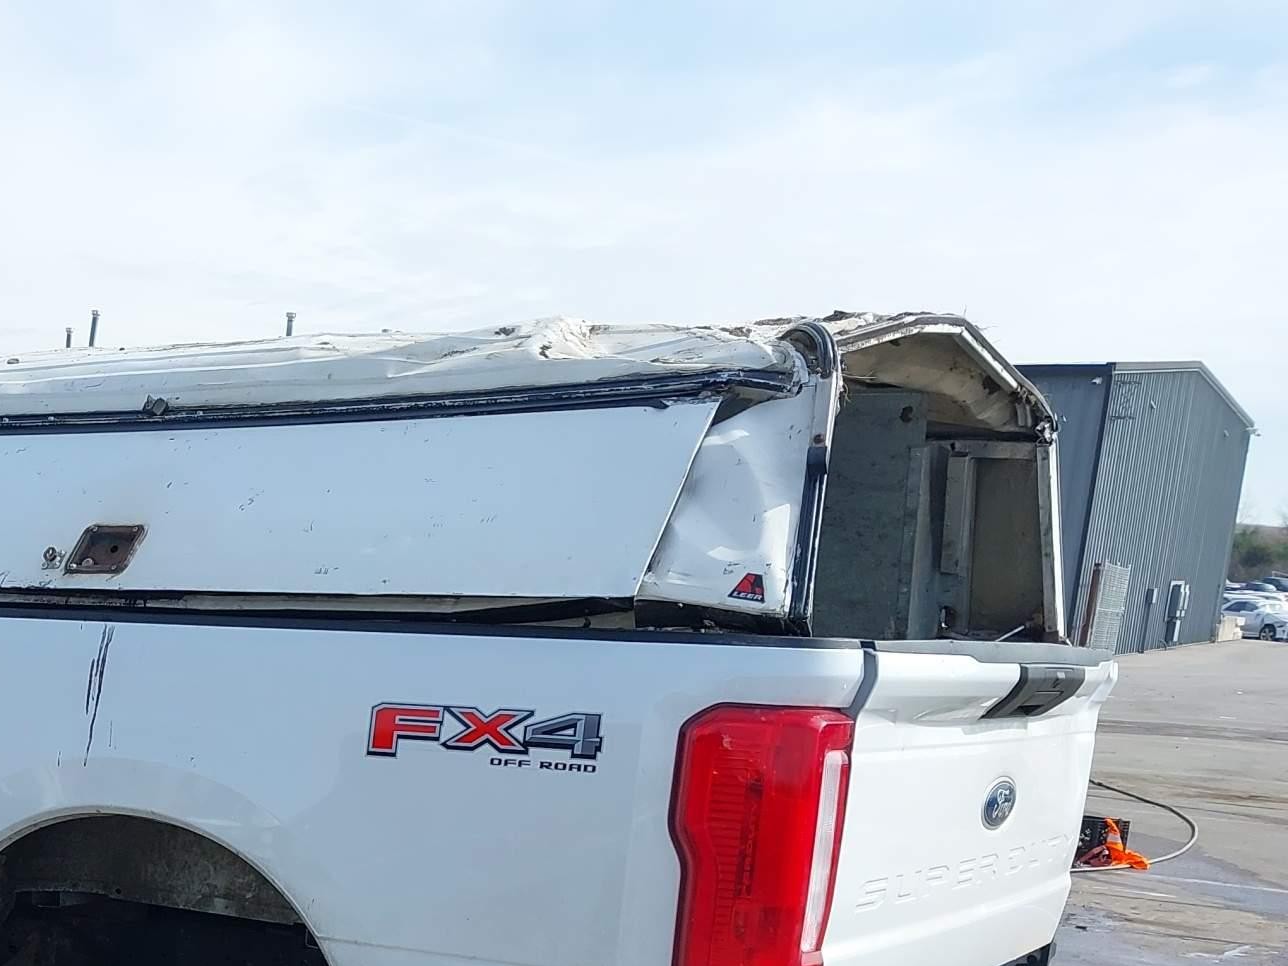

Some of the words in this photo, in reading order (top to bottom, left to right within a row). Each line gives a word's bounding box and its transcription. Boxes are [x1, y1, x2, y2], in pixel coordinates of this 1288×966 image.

[732, 591, 763, 602] LEER
[366, 702, 603, 760] FX4
[490, 757, 532, 769] OFF
[539, 761, 597, 774] ROAD
[855, 853, 1000, 914] SUPER
